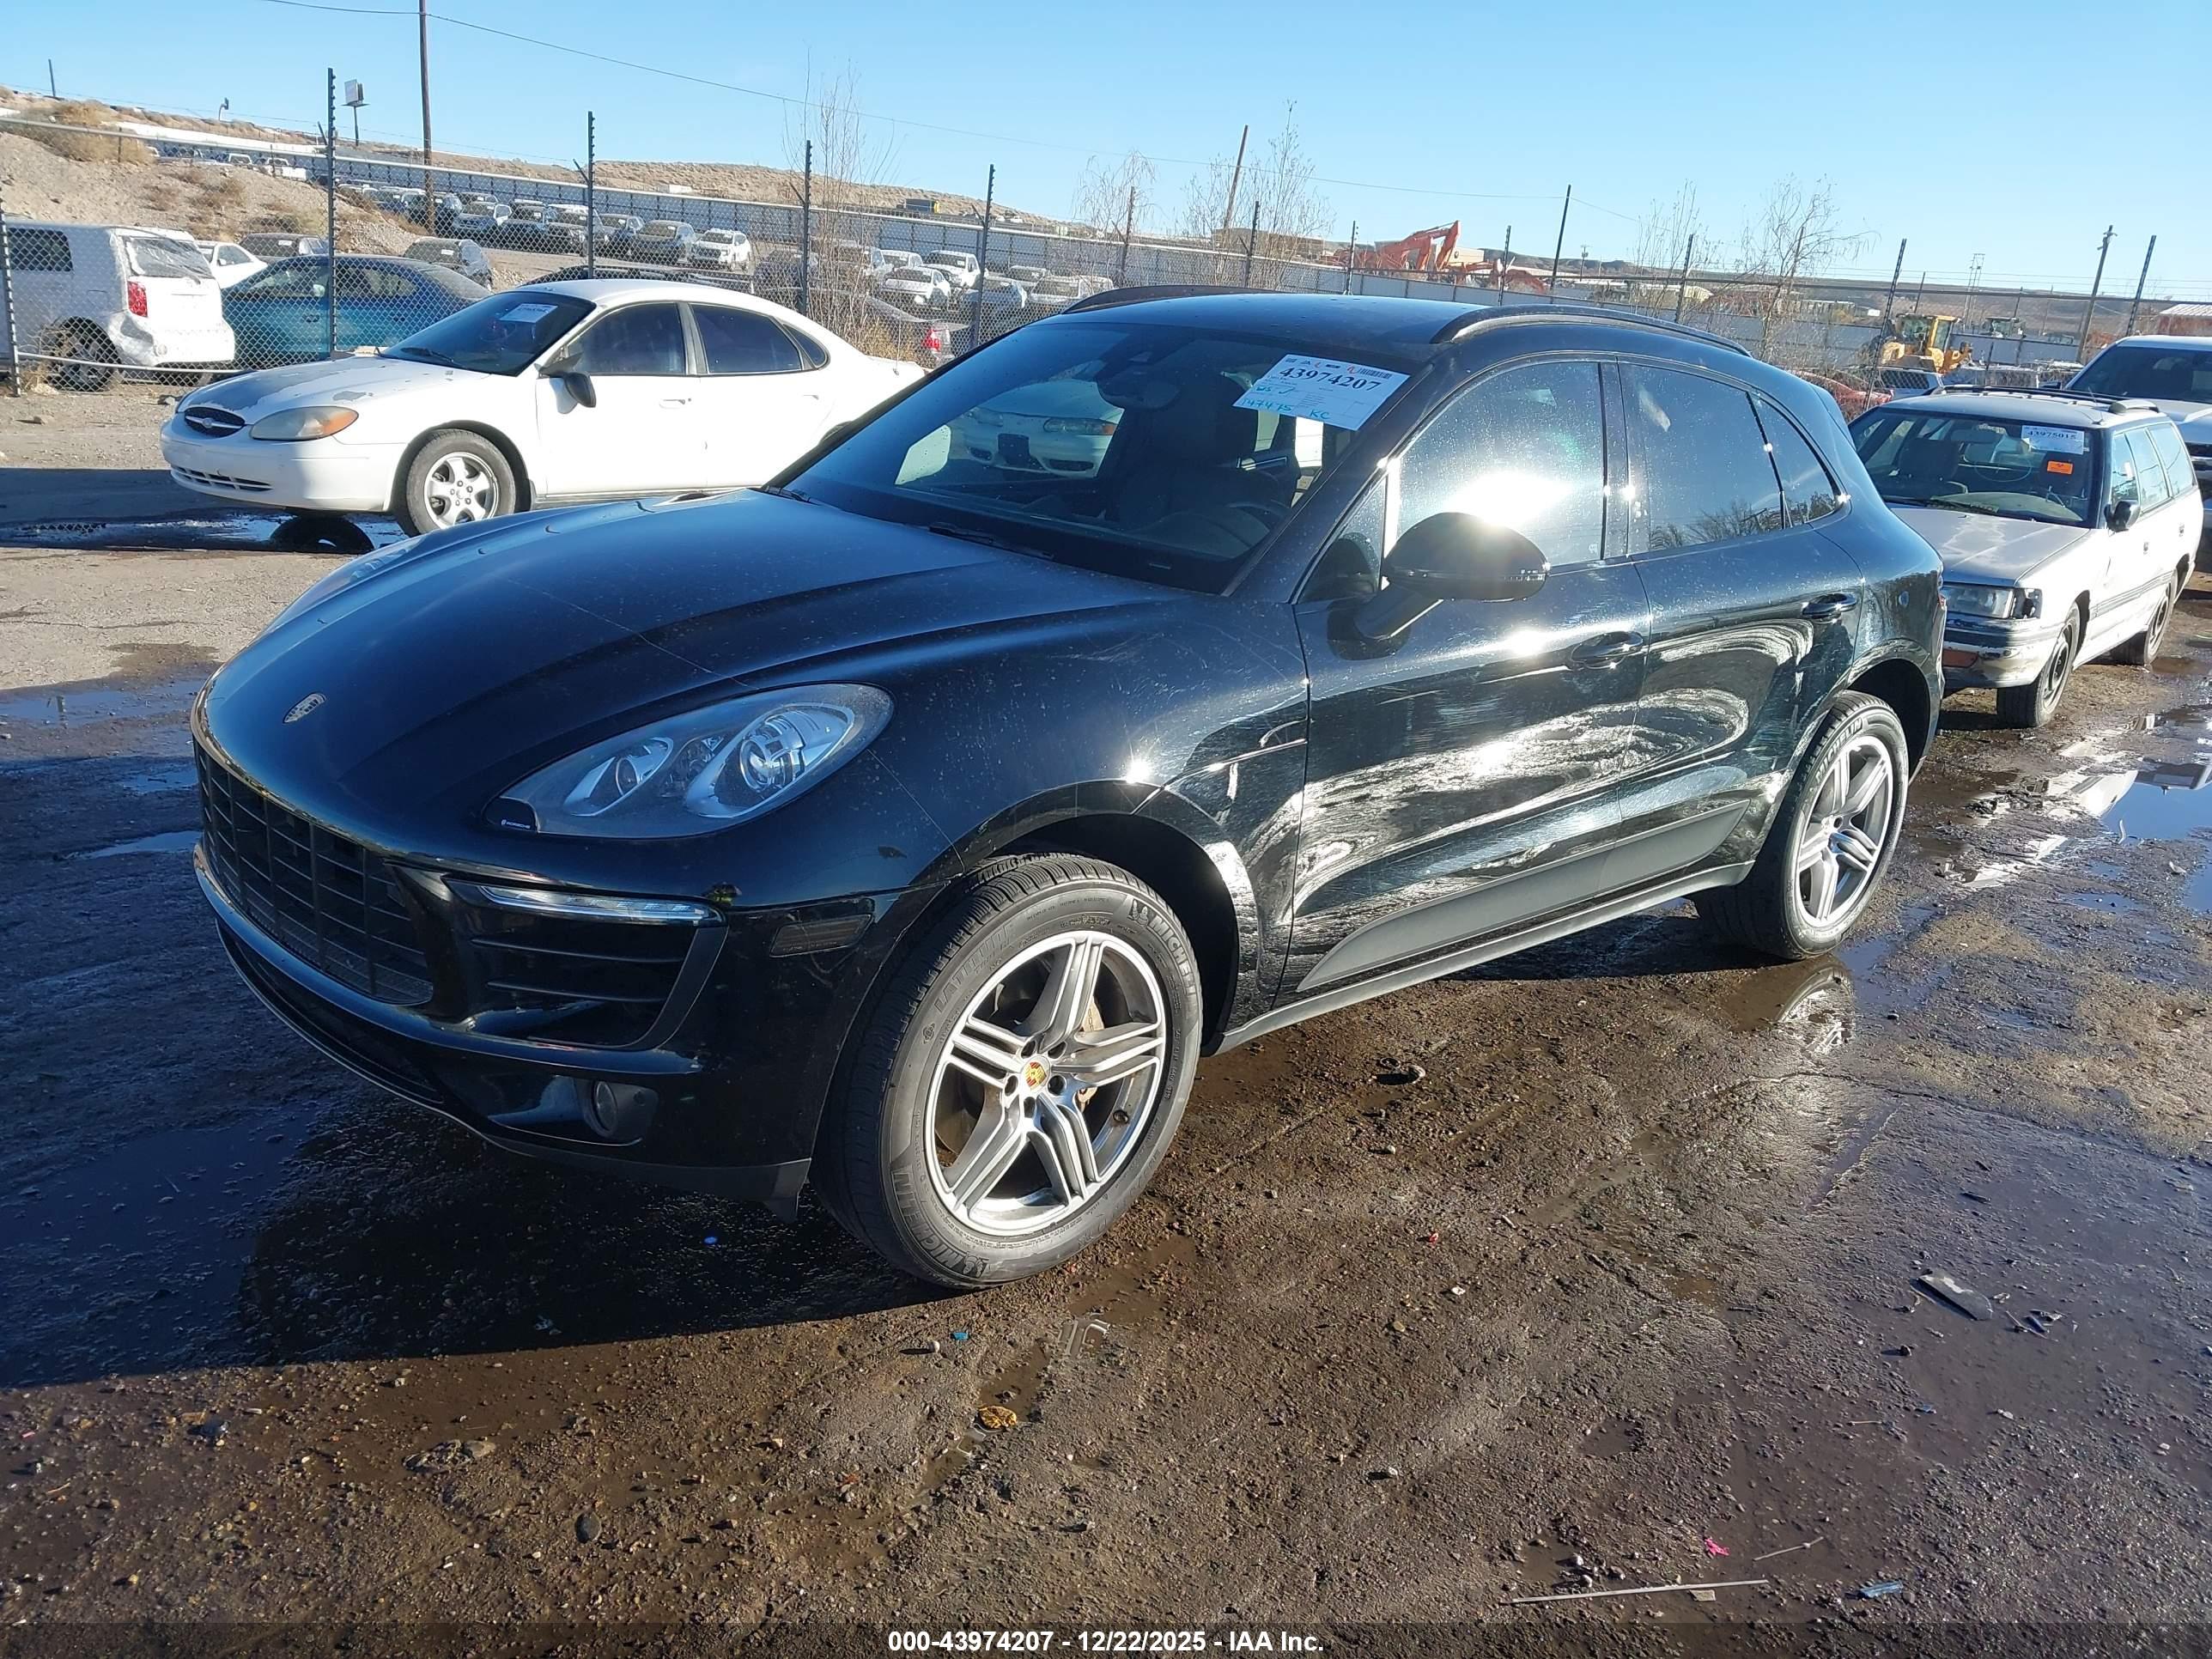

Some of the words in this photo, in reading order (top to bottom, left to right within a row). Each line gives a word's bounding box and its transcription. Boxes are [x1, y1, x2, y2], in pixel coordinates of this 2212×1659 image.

[1279, 367, 1382, 391] 43974207
[1815, 718, 1863, 782] MICHELIN
[891, 1171, 963, 1268] MICHELIN
